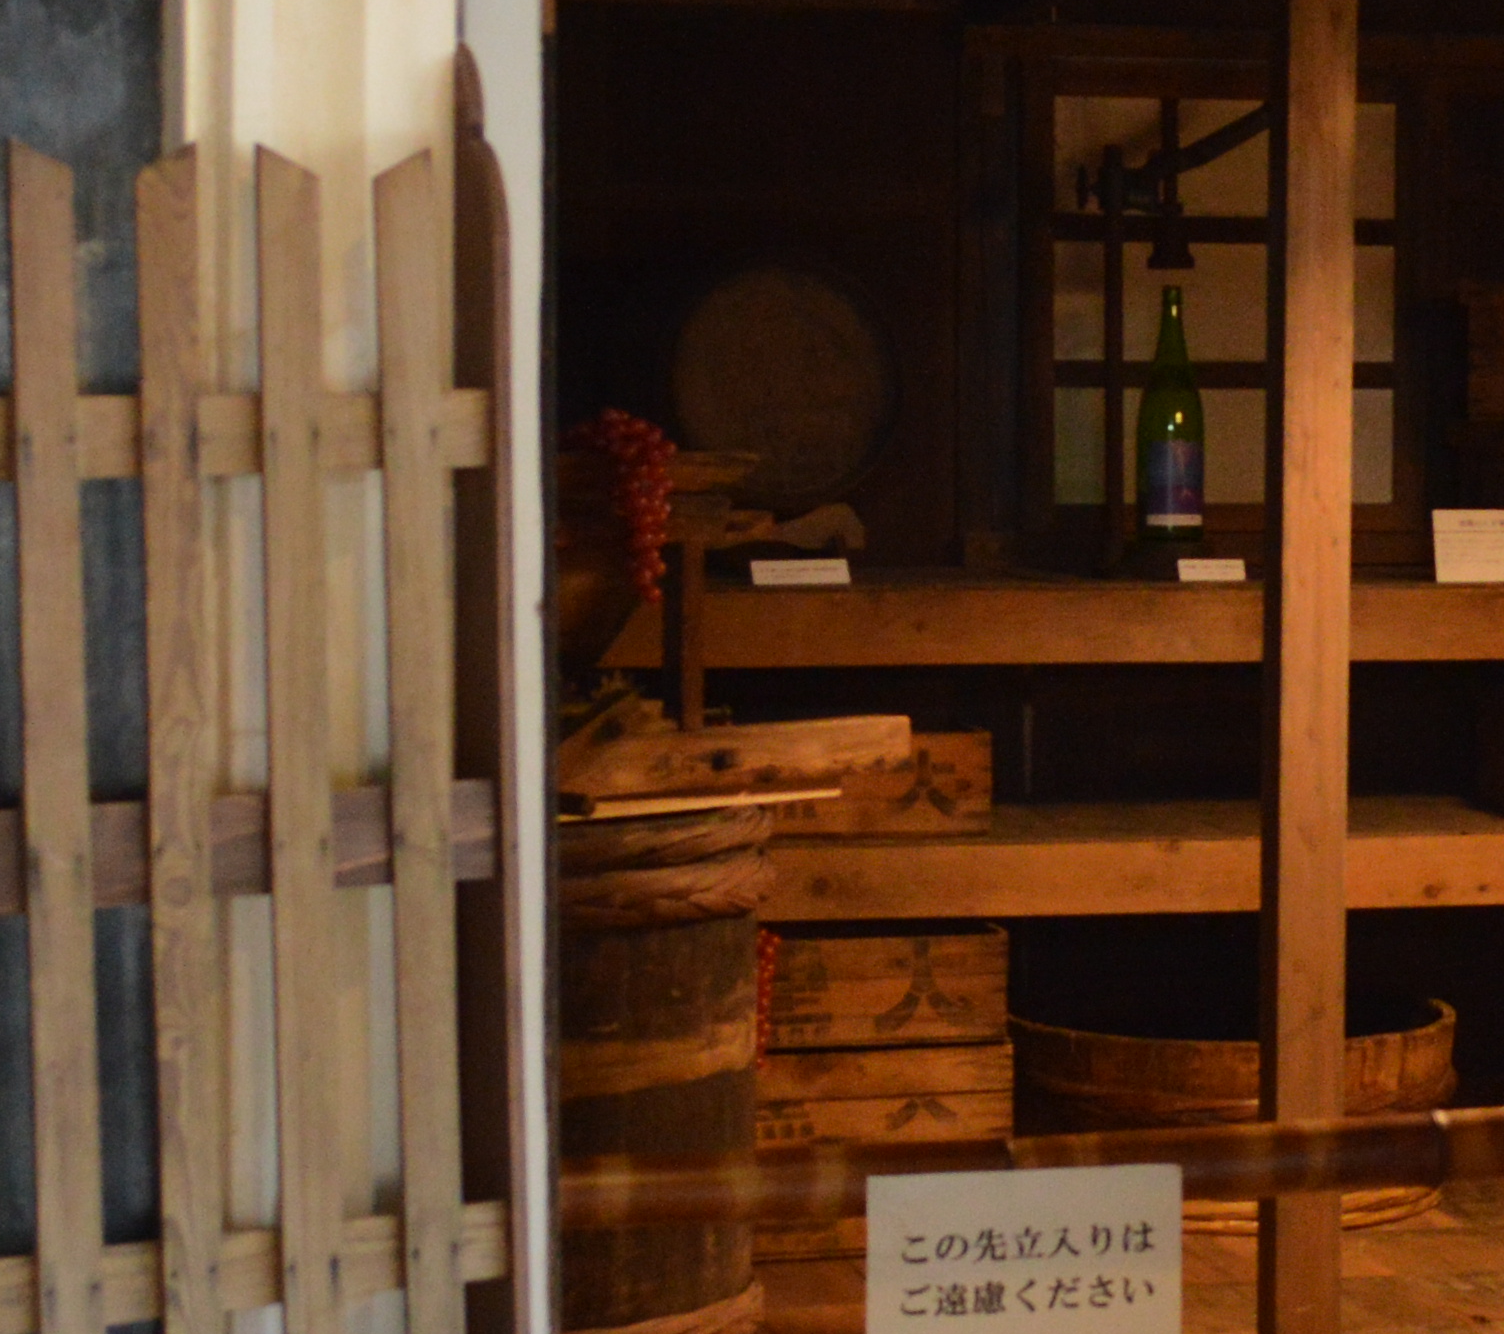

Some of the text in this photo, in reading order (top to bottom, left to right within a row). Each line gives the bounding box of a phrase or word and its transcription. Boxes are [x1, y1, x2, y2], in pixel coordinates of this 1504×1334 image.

[901, 1221, 1154, 1264] この先立入りは
[900, 1274, 1155, 1316] ご遠慮ください
